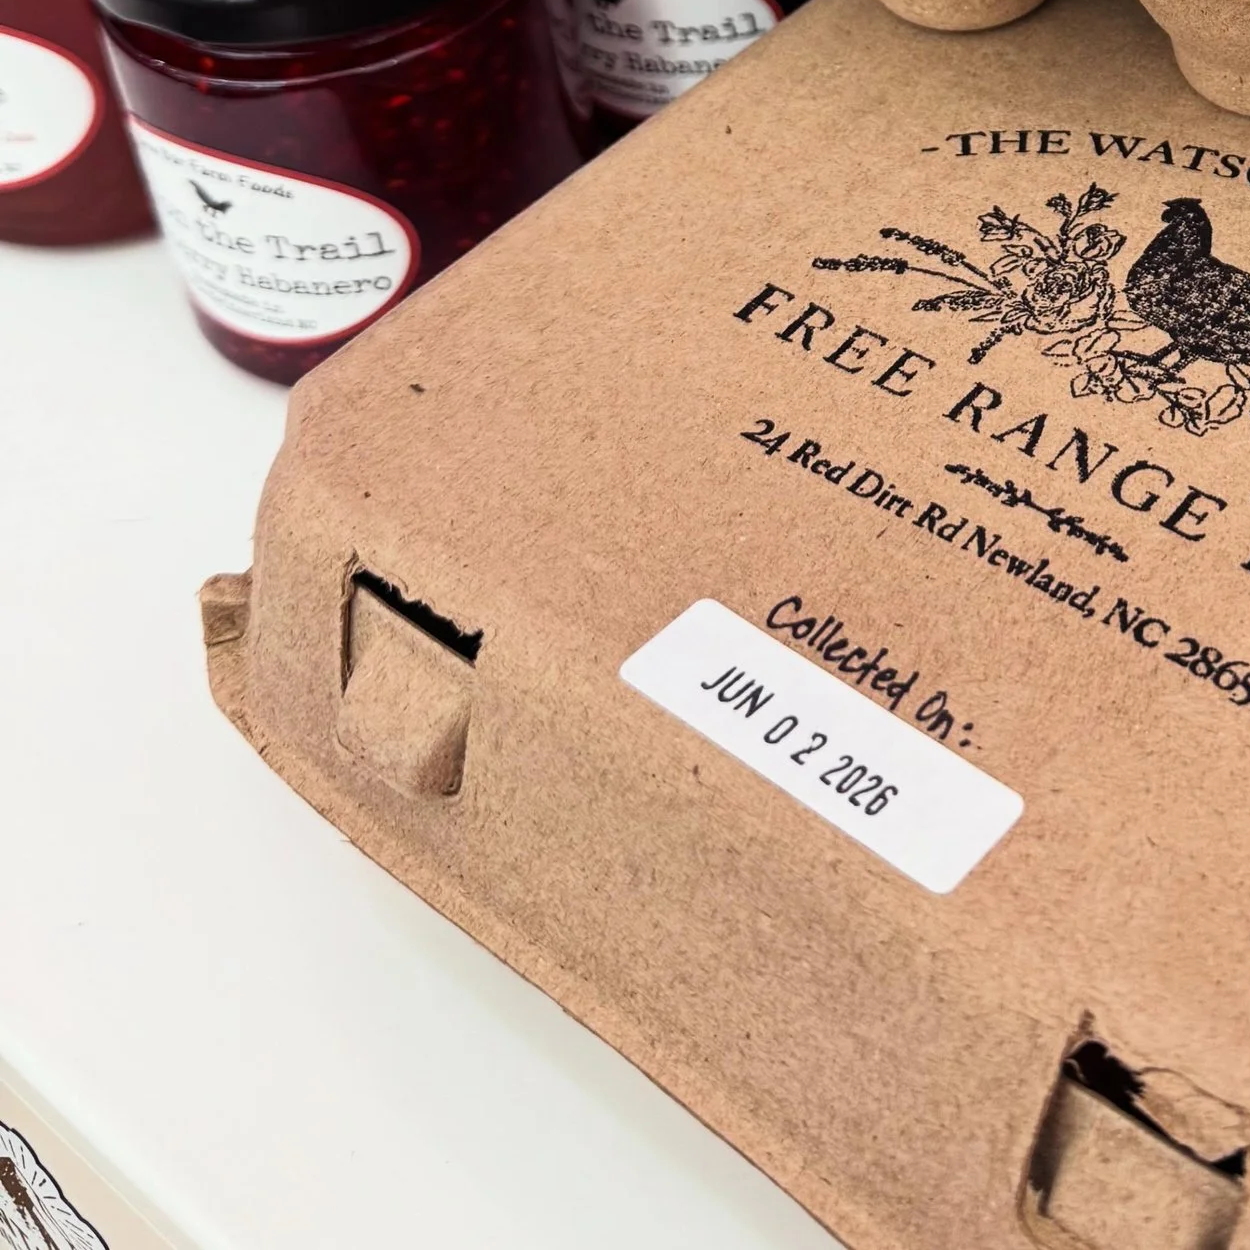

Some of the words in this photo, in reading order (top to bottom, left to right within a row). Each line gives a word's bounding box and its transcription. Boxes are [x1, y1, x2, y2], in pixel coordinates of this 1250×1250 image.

[650, 10, 768, 46] Trail
[235, 263, 393, 296] Habanero
[265, 231, 397, 261] Trail
[733, 282, 937, 397] FREE
[942, 381, 1228, 542] RANGE
[740, 418, 792, 456] 24
[787, 437, 856, 485] Red
[846, 467, 915, 519] Dirt
[911, 500, 969, 543] Rd
[961, 524, 1101, 618] Newland,
[1101, 598, 1172, 647] NC
[701, 665, 776, 719] JUN
[818, 754, 899, 816] 2026
[766, 594, 920, 711] Collected
[915, 690, 975, 749] On:
